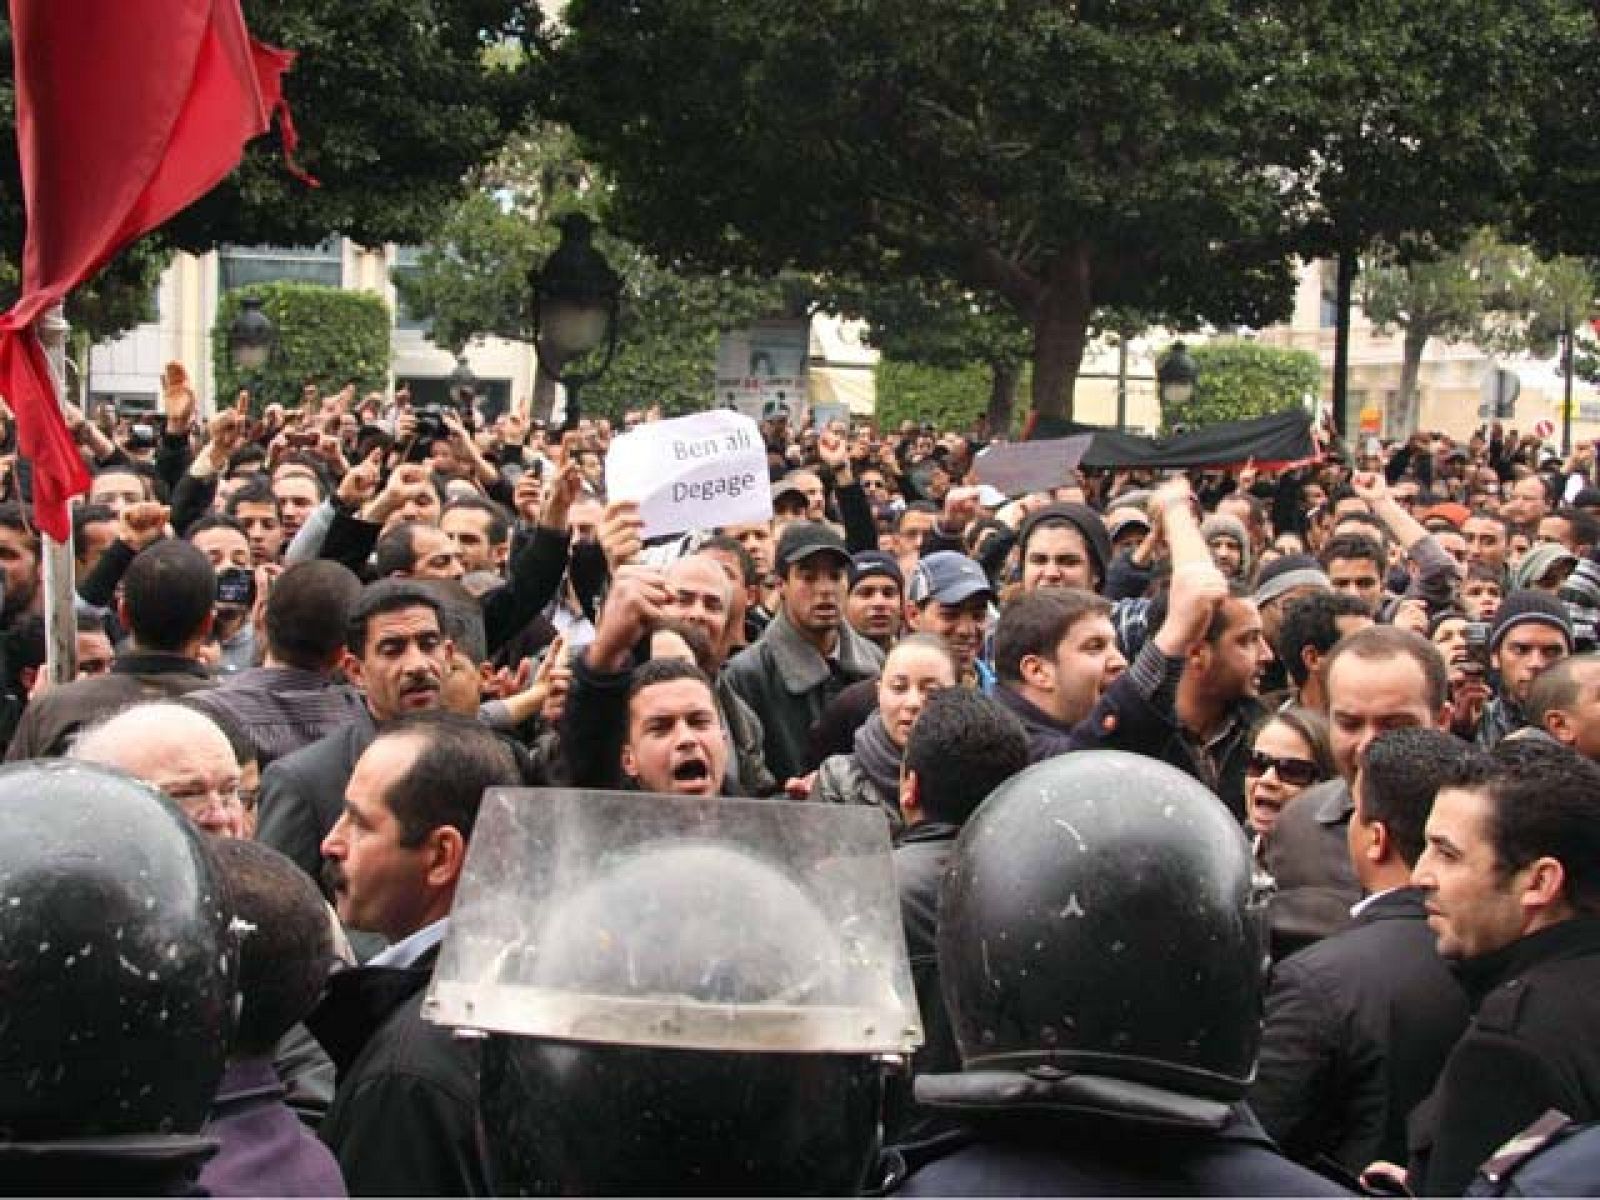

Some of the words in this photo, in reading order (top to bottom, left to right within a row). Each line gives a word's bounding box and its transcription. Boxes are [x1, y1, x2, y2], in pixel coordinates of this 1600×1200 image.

[672, 439, 718, 460] Ben
[725, 429, 751, 451] ali
[672, 472, 756, 503] Degage
